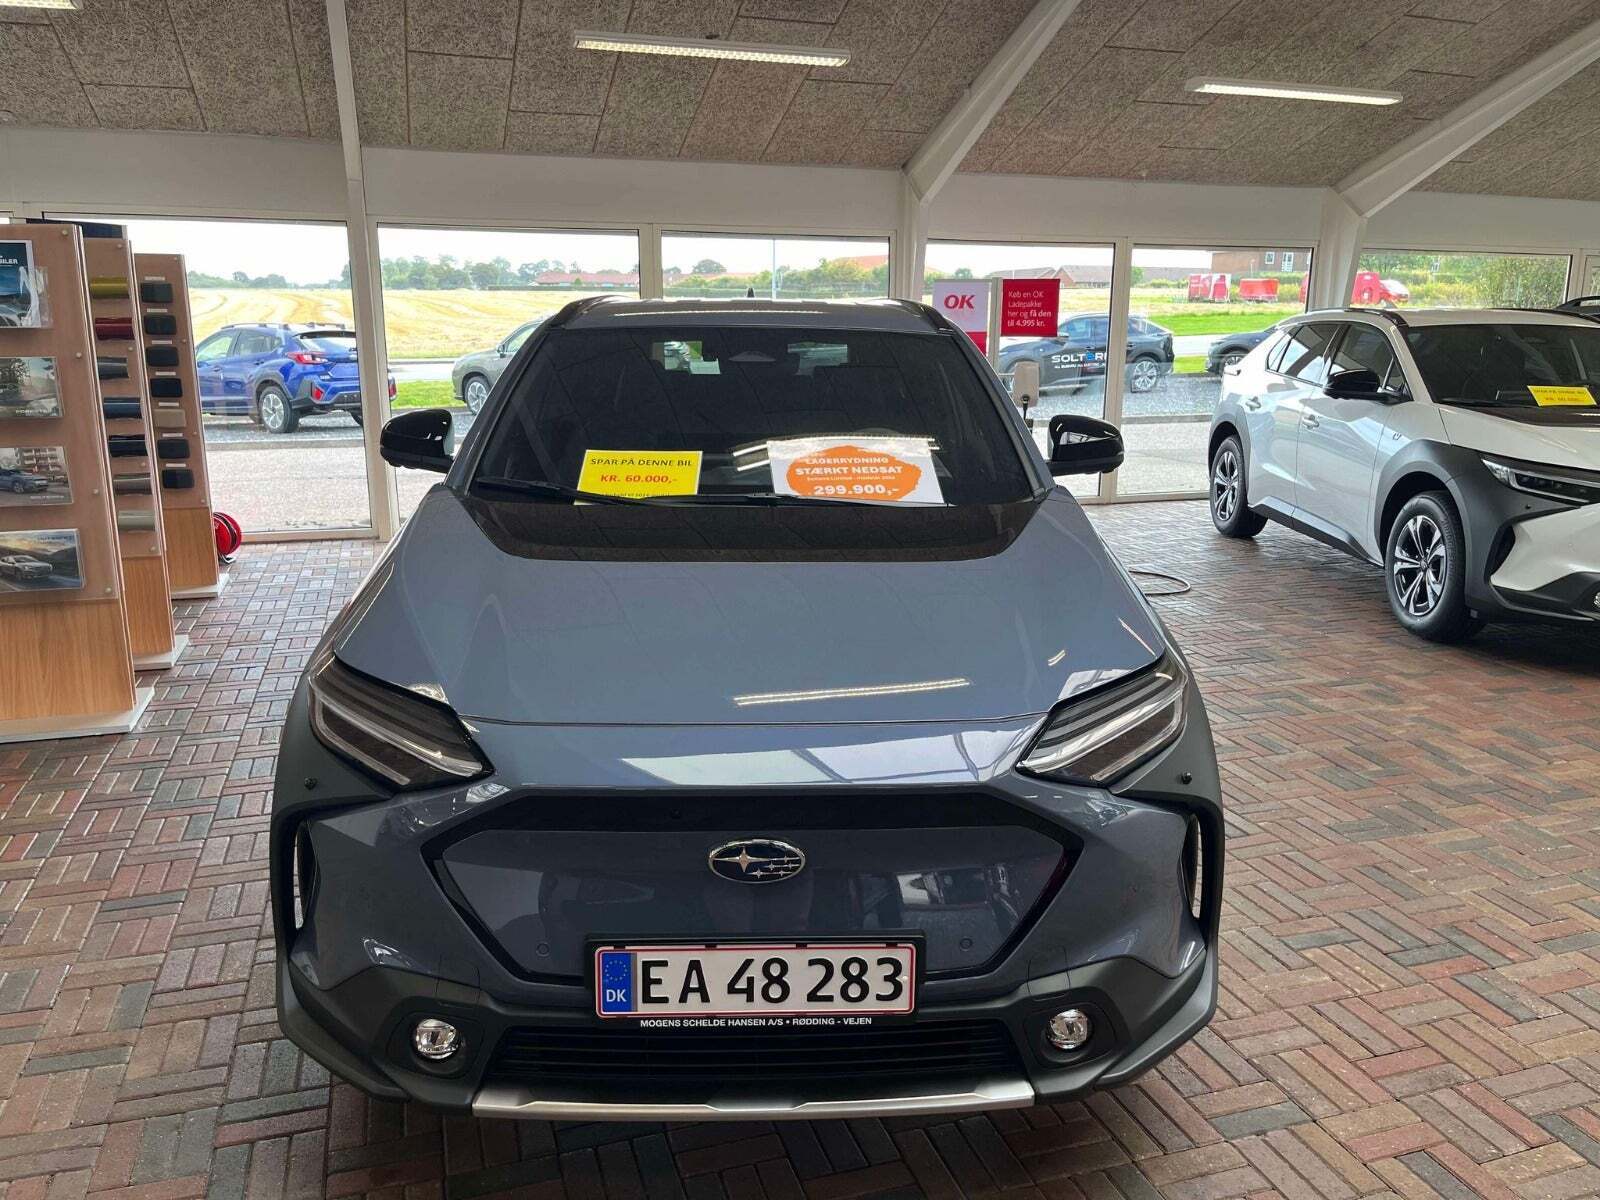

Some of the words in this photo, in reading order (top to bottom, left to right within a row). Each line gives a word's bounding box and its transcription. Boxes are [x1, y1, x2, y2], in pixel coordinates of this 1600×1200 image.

[1008, 290, 1021, 298] Køb
[1033, 290, 1044, 298] OK
[944, 294, 975, 309] OK
[623, 458, 635, 466] PÅ
[795, 466, 849, 476] STÆRKT
[852, 465, 904, 475] NEDSAT
[600, 474, 621, 483] KR.
[625, 474, 678, 484] 60.000,-
[813, 485, 899, 496] 299.900,-
[606, 989, 627, 1003] DK
[641, 959, 711, 1004] EA
[727, 957, 790, 1004] 48
[806, 956, 903, 1003] 283
[640, 1019, 681, 1028] MOGENS
[683, 1019, 726, 1027] SCHELDE
[727, 1018, 767, 1027] HANSEN
[768, 1018, 784, 1027] A/S
[792, 1017, 835, 1026] RØDDING
[843, 1017, 872, 1026] VEJEN
